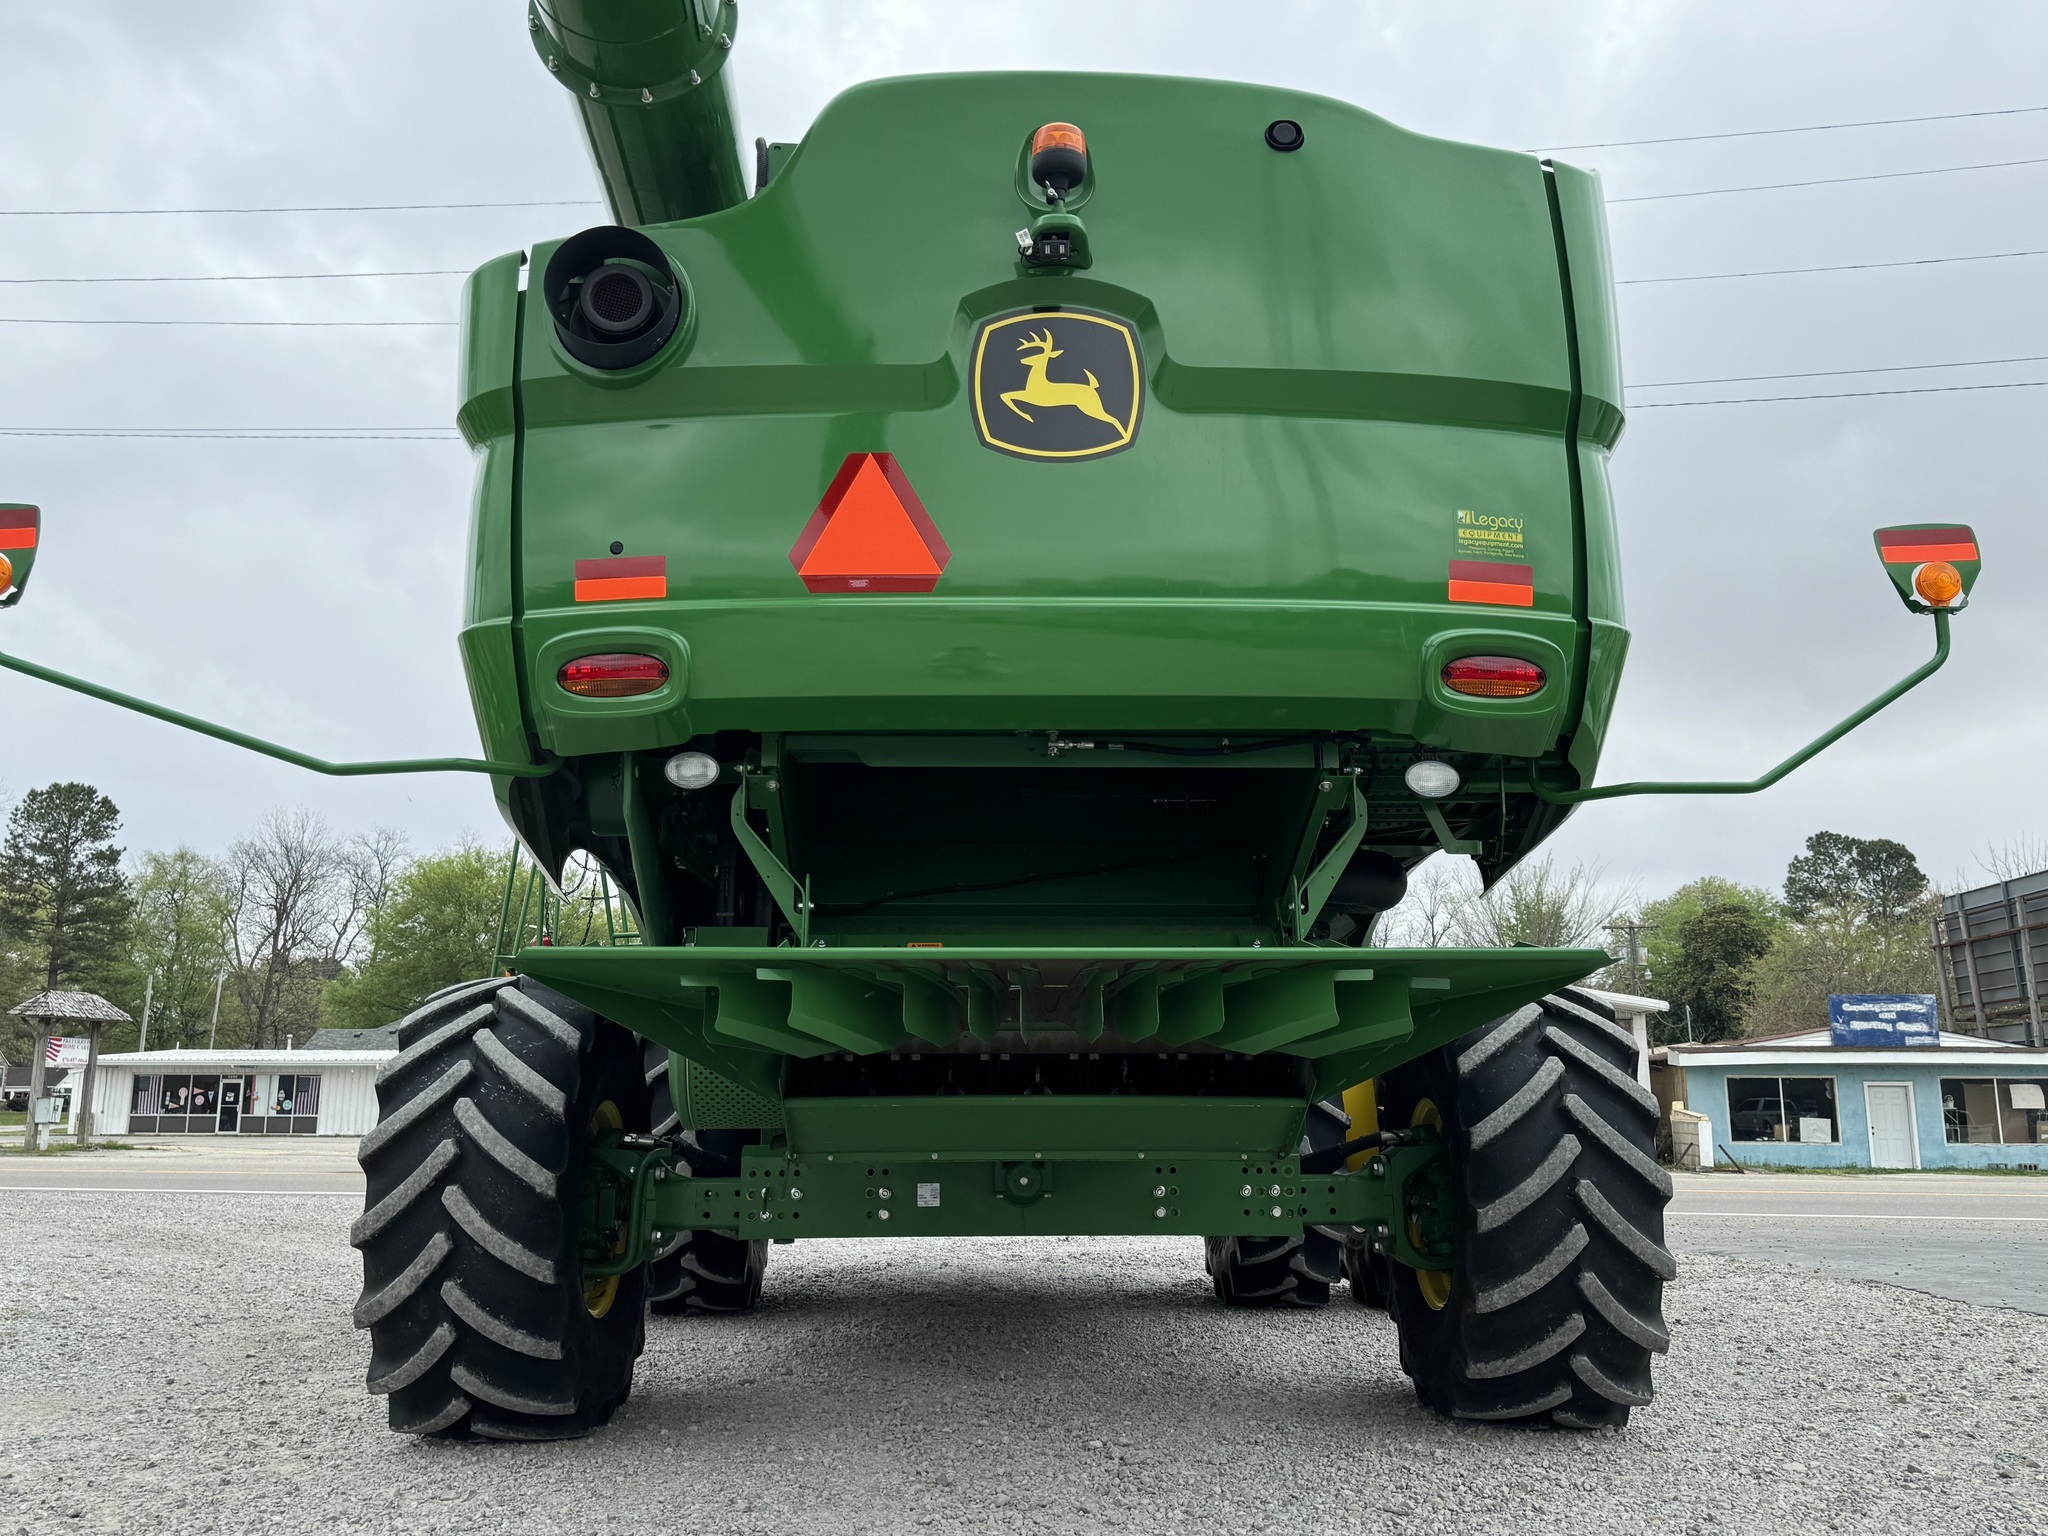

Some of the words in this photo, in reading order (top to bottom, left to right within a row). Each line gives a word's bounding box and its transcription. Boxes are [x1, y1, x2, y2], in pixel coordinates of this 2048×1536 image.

[1471, 510, 1523, 532] Legacy
[1462, 530, 1519, 541] EQUIPMENT
[1458, 538, 1524, 549] legacyequipment.com
